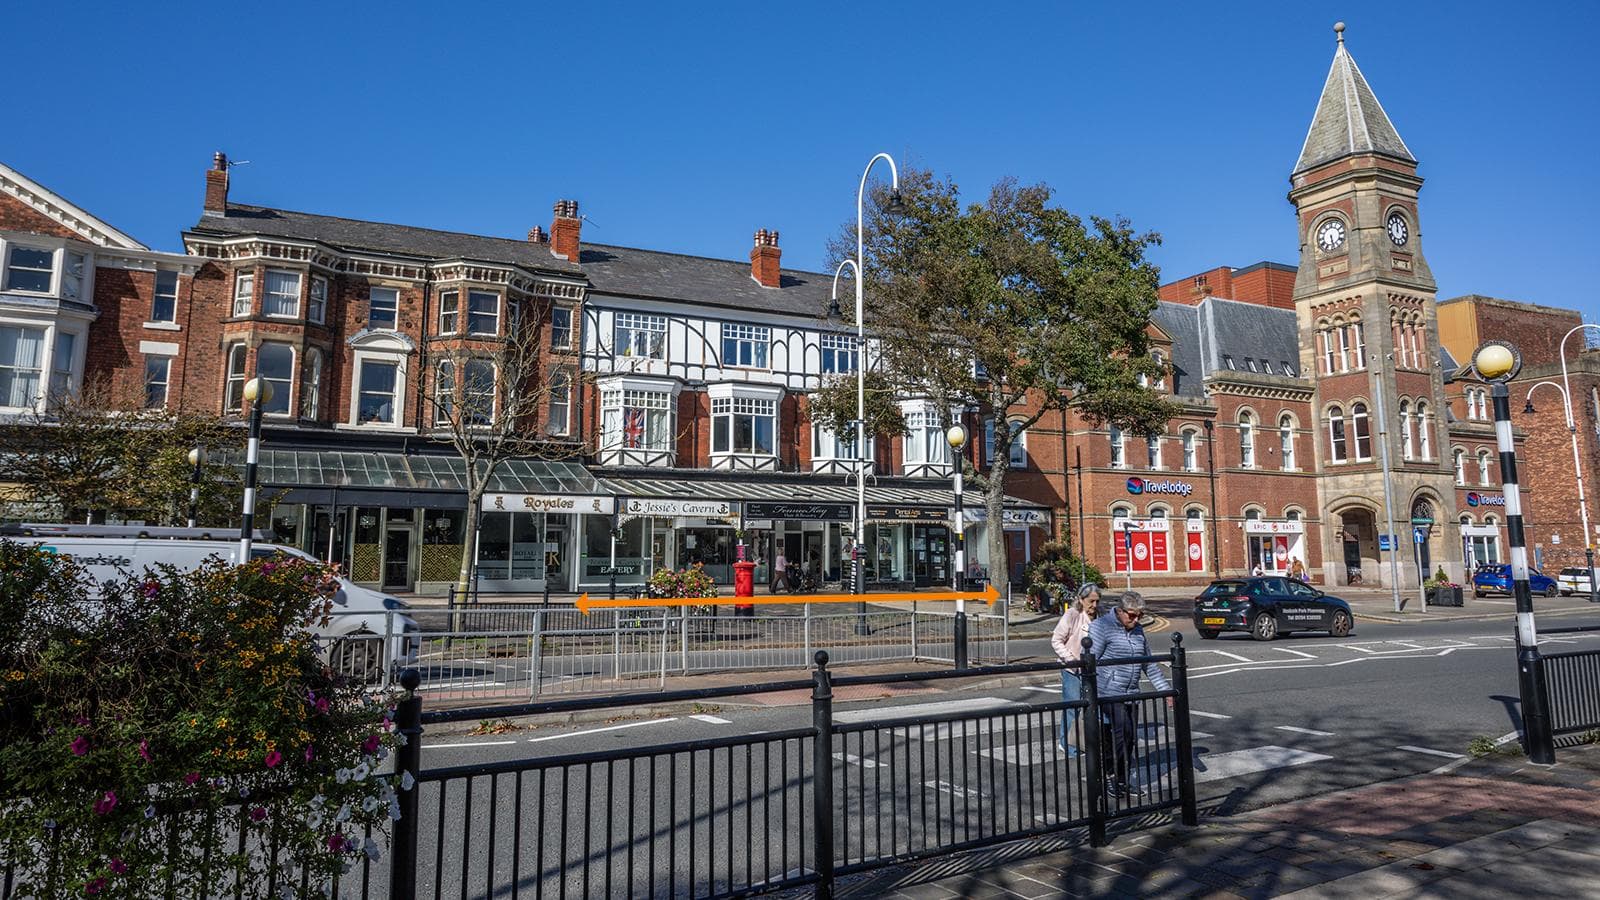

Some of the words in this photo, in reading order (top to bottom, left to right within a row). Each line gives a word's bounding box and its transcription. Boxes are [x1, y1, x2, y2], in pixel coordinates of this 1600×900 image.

[1143, 479, 1192, 497] Travelodge
[523, 497, 575, 512] Royales
[643, 502, 677, 514] Jessie's
[682, 503, 715, 513] Cavern
